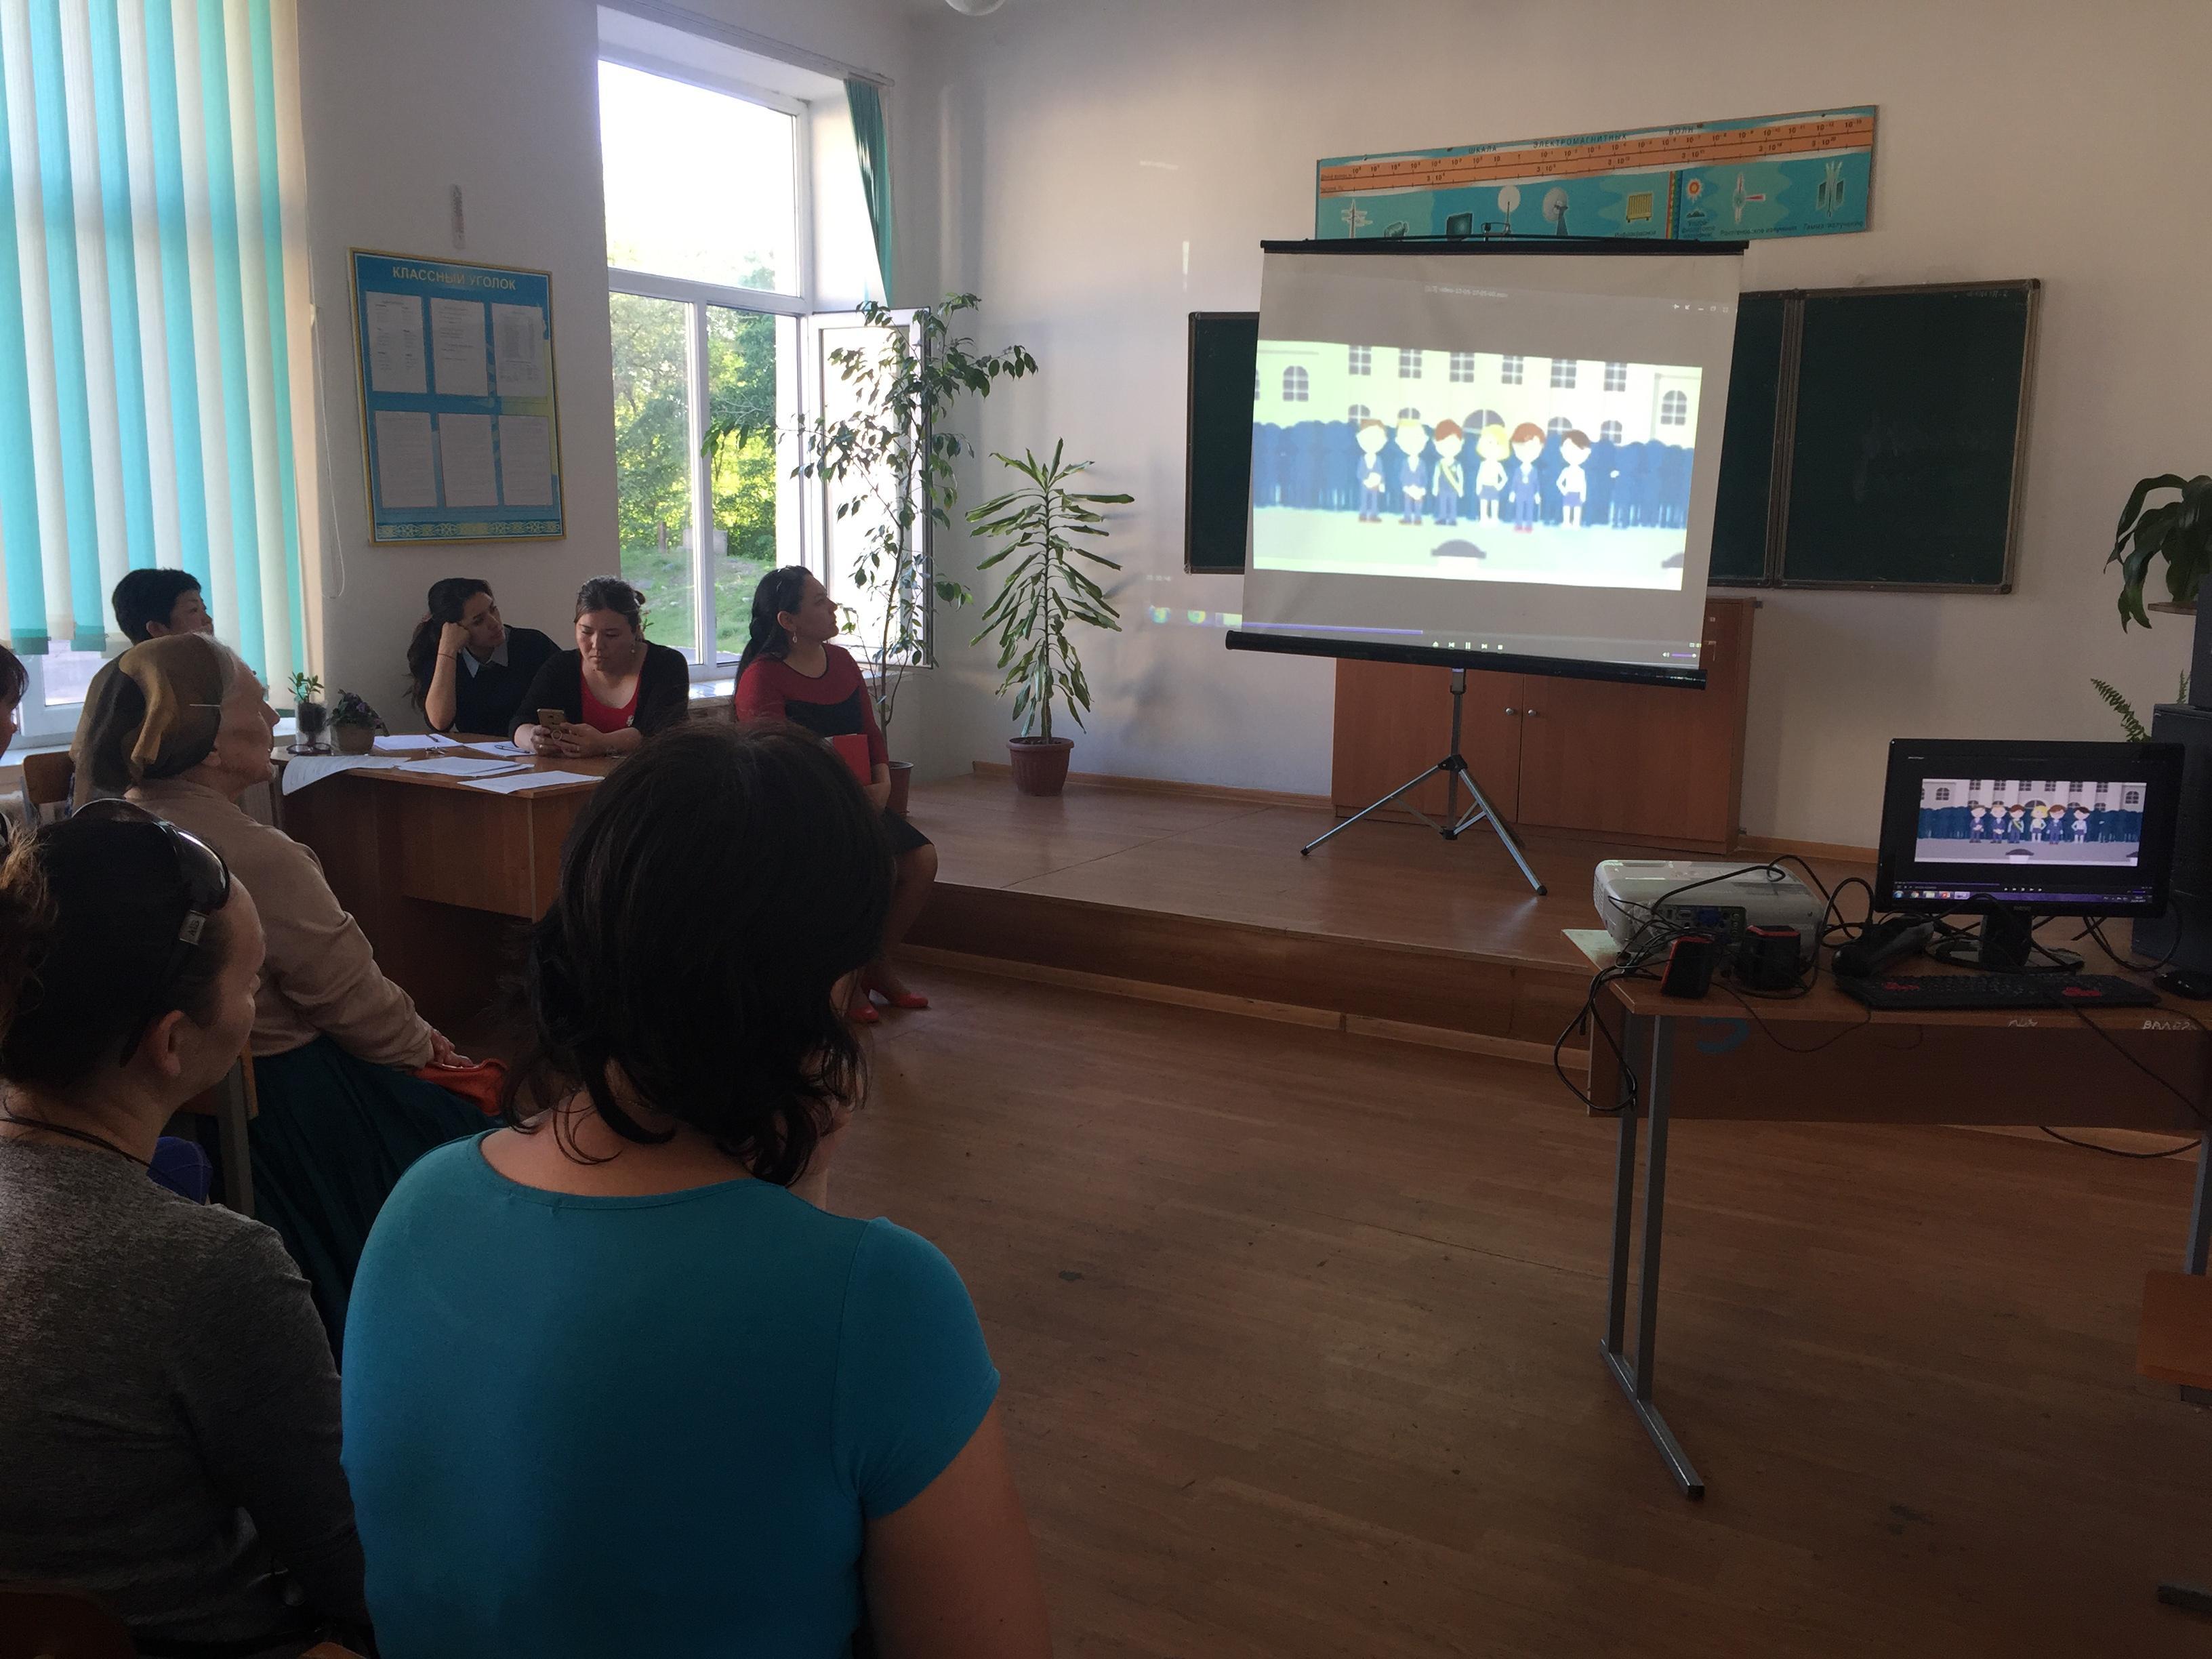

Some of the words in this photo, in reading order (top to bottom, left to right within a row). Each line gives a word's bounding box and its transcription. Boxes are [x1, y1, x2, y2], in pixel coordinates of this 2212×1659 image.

[1469, 145, 1497, 154] ШКАЛА
[1533, 133, 1628, 148] ЭЛЕКТРОМАГНИТНЫХ
[1668, 126, 1694, 136] ВОЛН
[468, 275, 516, 290] УГОЛОК
